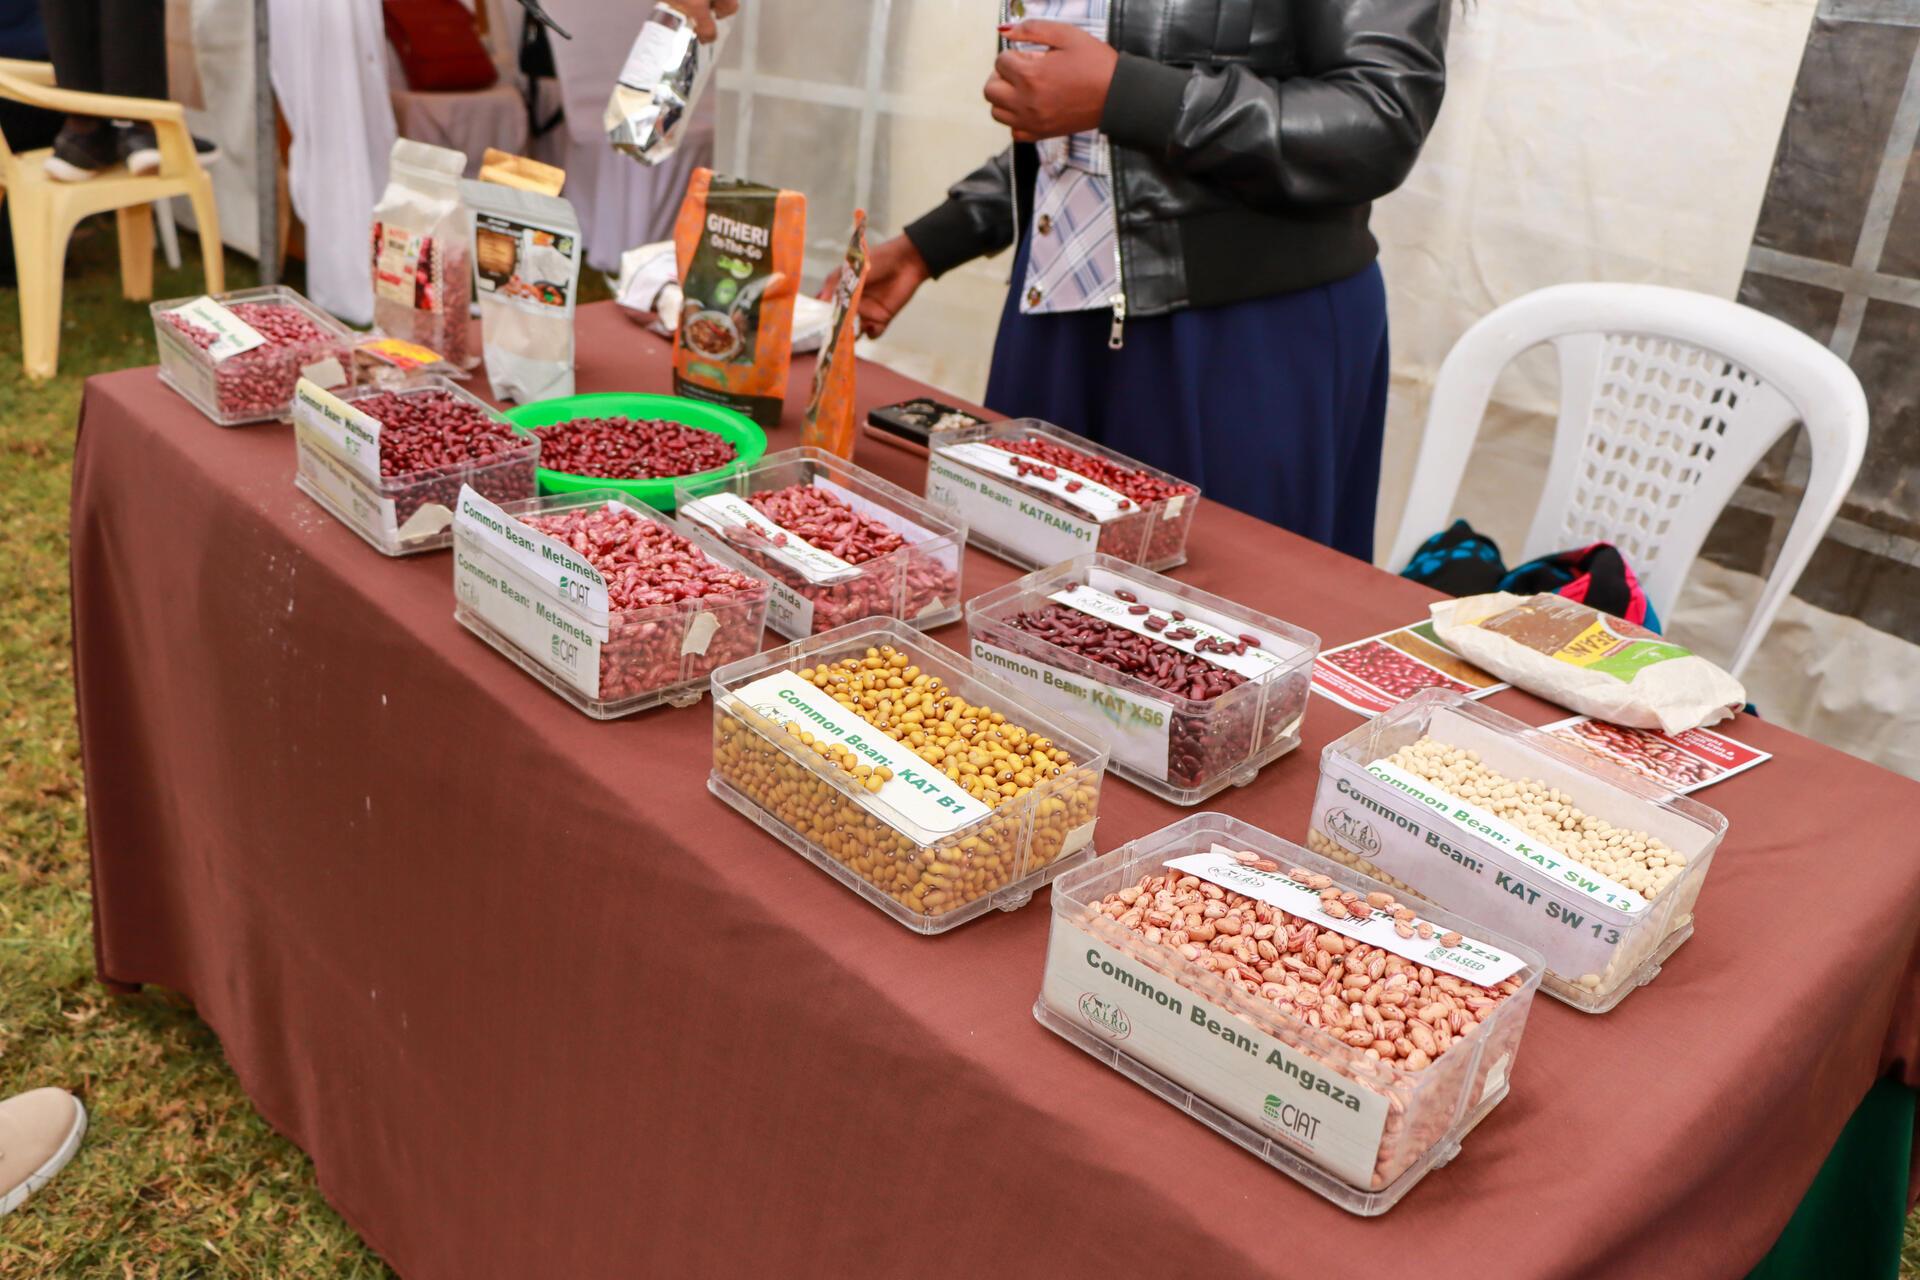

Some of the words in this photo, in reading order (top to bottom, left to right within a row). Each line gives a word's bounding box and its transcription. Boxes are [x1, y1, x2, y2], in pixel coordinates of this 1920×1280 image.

[707, 213, 769, 248] GITHERI
[711, 234, 763, 260] On-The-Go
[930, 460, 977, 490] Common
[979, 483, 1013, 508] Bean:
[1019, 501, 1092, 543] KATRAM-01
[463, 501, 503, 535] Common
[505, 526, 535, 553] Bean:
[542, 545, 602, 585] Metameta
[457, 553, 498, 588] Common
[501, 580, 530, 609] Bean:
[536, 602, 593, 647] Metameta
[569, 580, 590, 607] CIAT
[771, 582, 801, 609] Faida
[560, 639, 578, 669] CIAT
[1562, 630, 1619, 659] BEANS
[975, 643, 1038, 680] Common
[1043, 670, 1087, 699] Bean:
[1092, 689, 1127, 713] KAT
[1130, 702, 1165, 728] X56
[777, 688, 846, 737] Common
[844, 734, 894, 767] Bean:
[897, 768, 941, 795] KAT
[935, 795, 967, 814] B1
[1327, 813, 1379, 851] KALRO
[1367, 766, 1449, 813] Common
[1452, 809, 1511, 845] Bean:
[1514, 843, 1561, 870] KAT
[1563, 869, 1601, 893] SW
[1605, 893, 1632, 912] 13
[1336, 777, 1420, 837] Common
[1424, 831, 1484, 874] Bean:
[1494, 870, 1541, 906] KAT
[1544, 901, 1584, 930] SW
[1591, 923, 1620, 945] 13
[1446, 952, 1486, 972] EASEED
[1082, 1001, 1128, 1034] KALRO
[1086, 948, 1183, 1015] Common
[1190, 1005, 1259, 1057] Bean:
[1265, 1047, 1361, 1113] Angaza
[1281, 1103, 1321, 1141] CIAT
